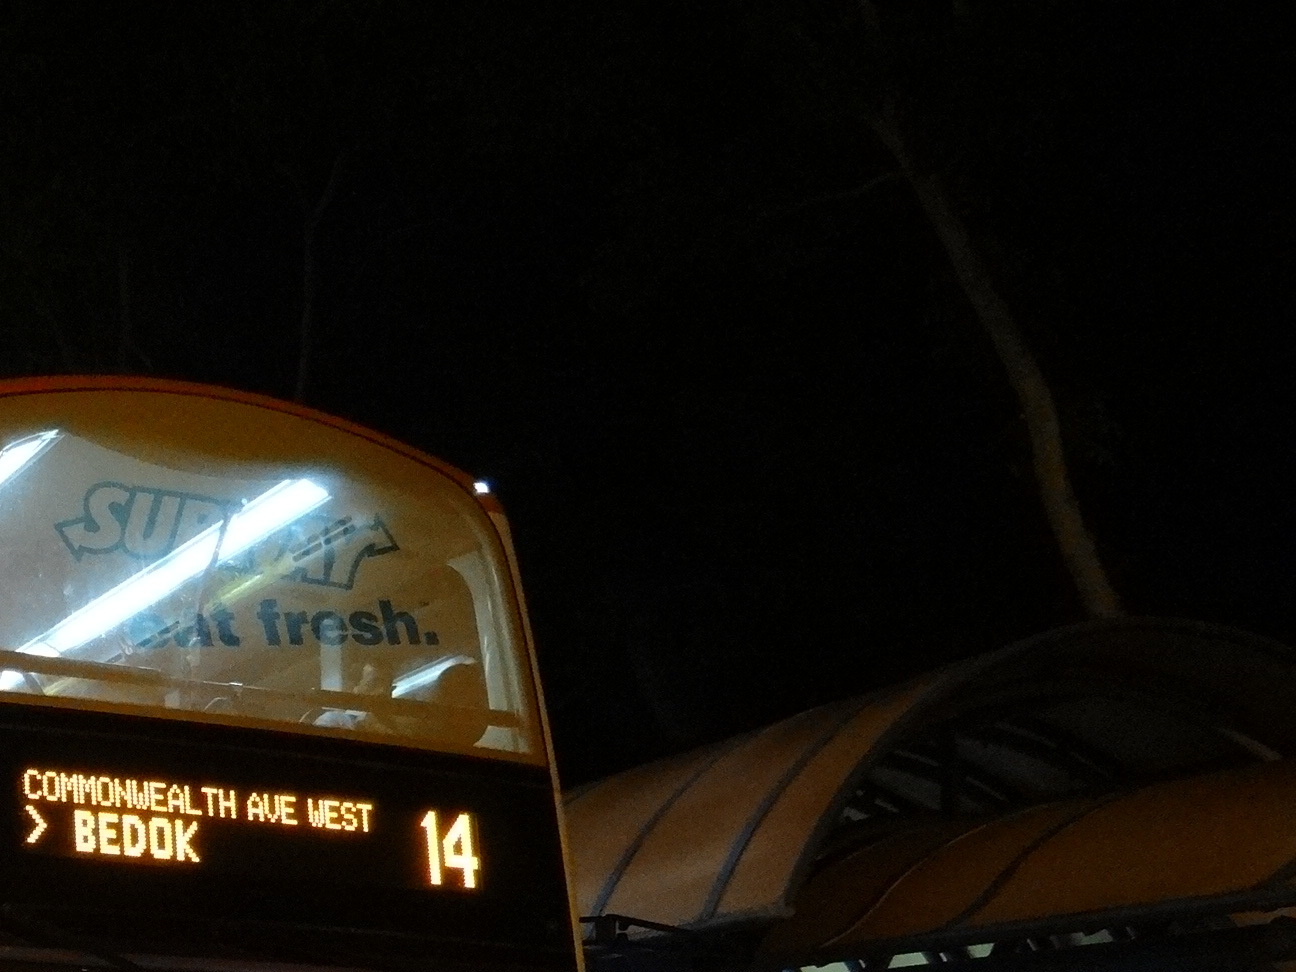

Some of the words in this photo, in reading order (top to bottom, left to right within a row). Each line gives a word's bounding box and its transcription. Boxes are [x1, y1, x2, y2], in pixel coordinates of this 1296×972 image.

[257, 598, 440, 647] fresh.
[23, 769, 237, 819] COMMONWEALTH
[247, 791, 299, 826] AVE
[307, 797, 374, 833] WEST
[74, 809, 201, 863] BEDOK
[420, 810, 480, 889] 14
